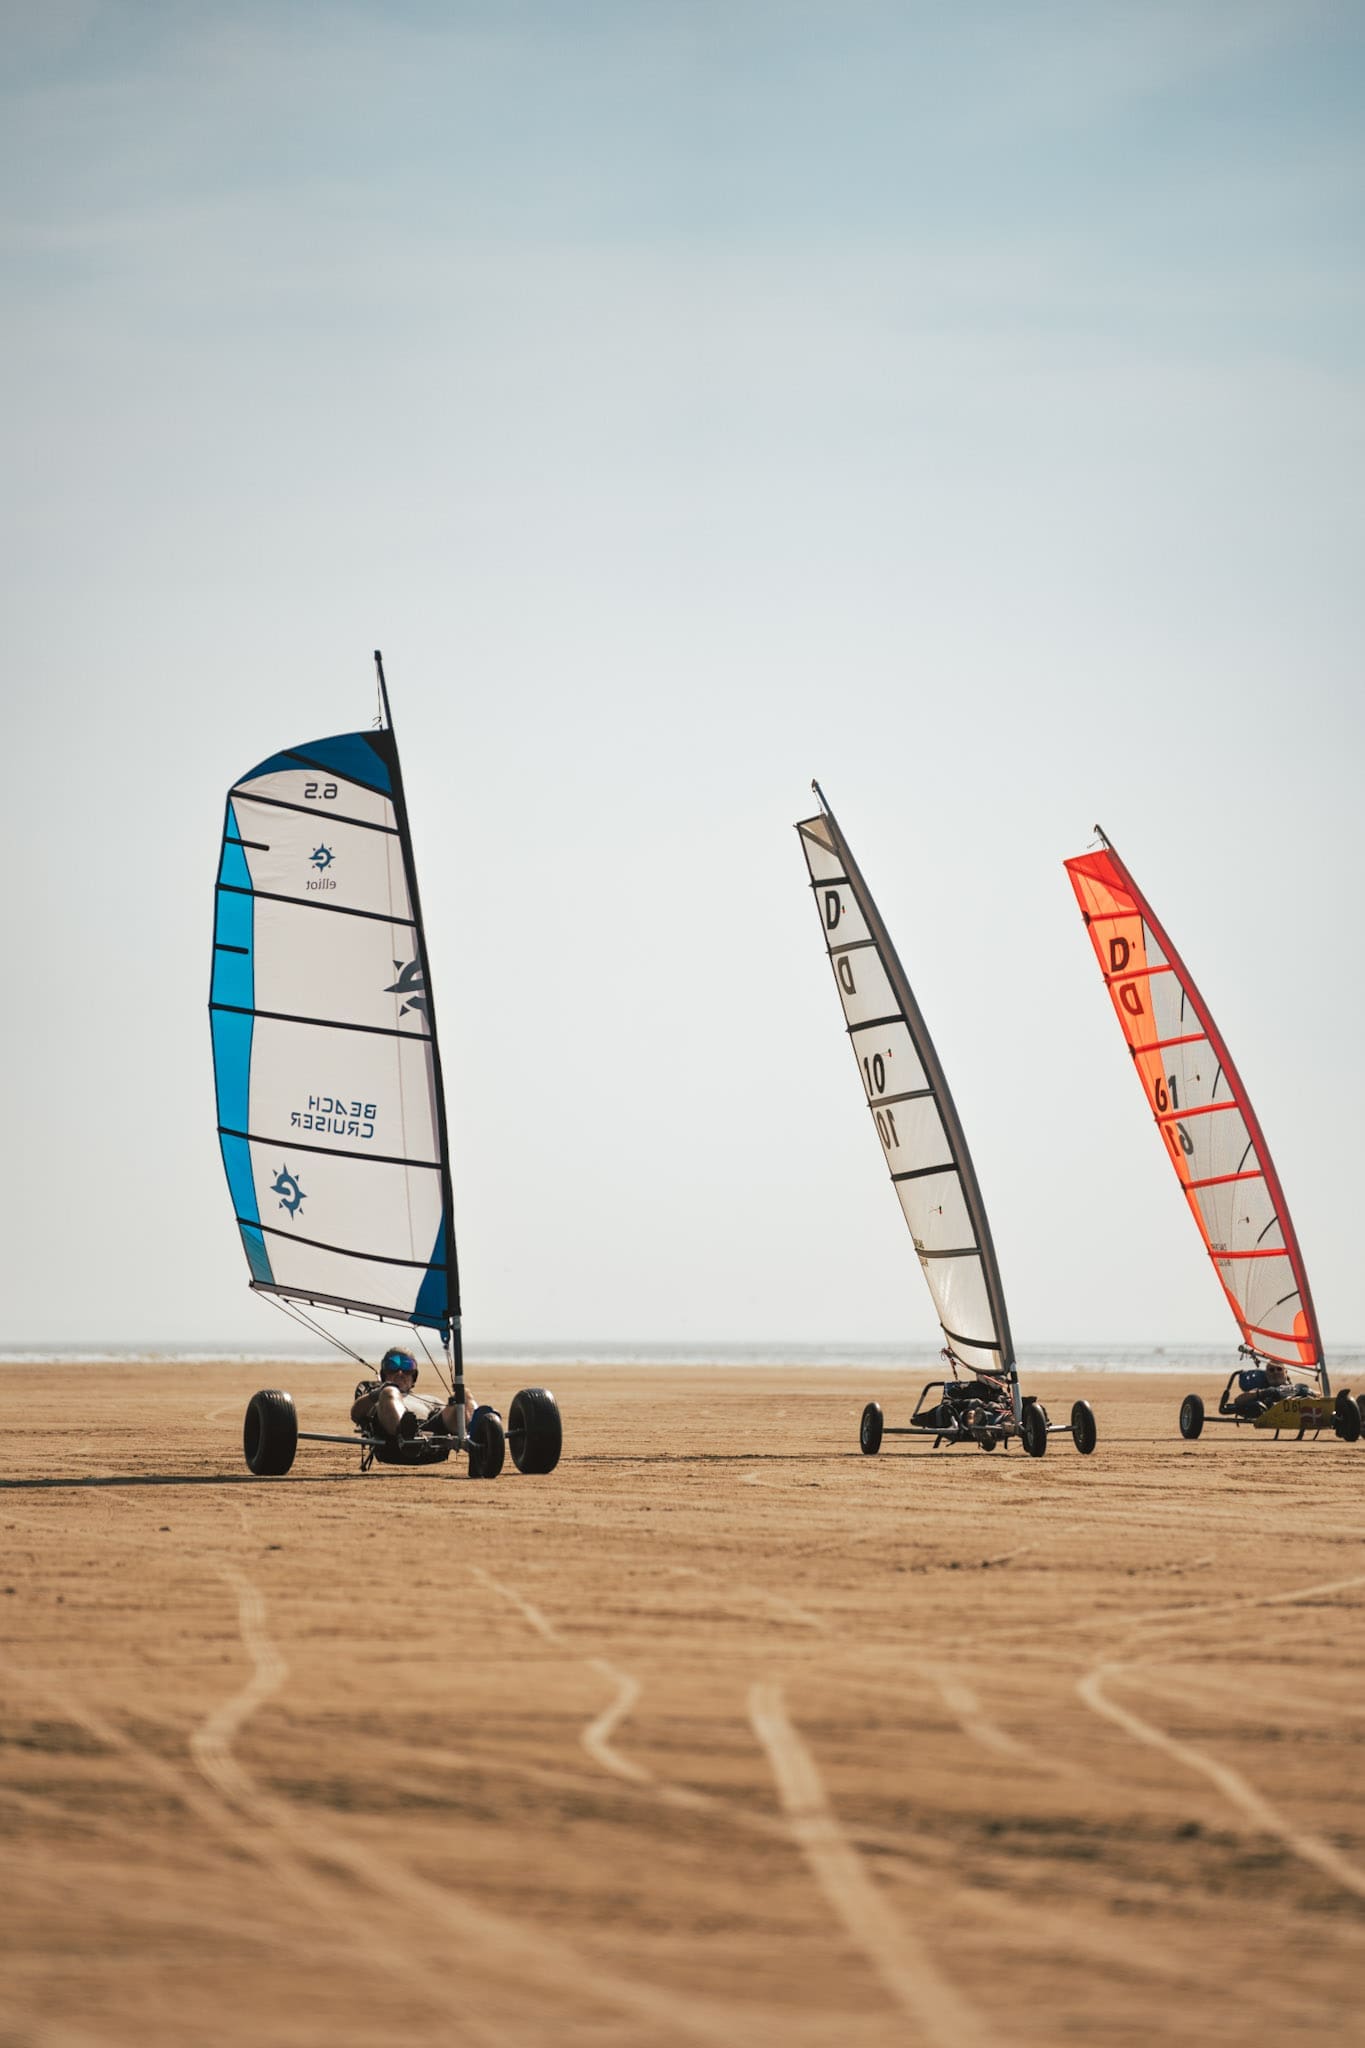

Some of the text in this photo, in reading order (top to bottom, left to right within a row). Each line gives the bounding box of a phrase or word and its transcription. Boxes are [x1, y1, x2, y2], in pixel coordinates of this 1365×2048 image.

[824, 890, 841, 930] D
[1109, 936, 1130, 973] D
[863, 1053, 886, 1097] 10
[1155, 1075, 1179, 1112] 61
